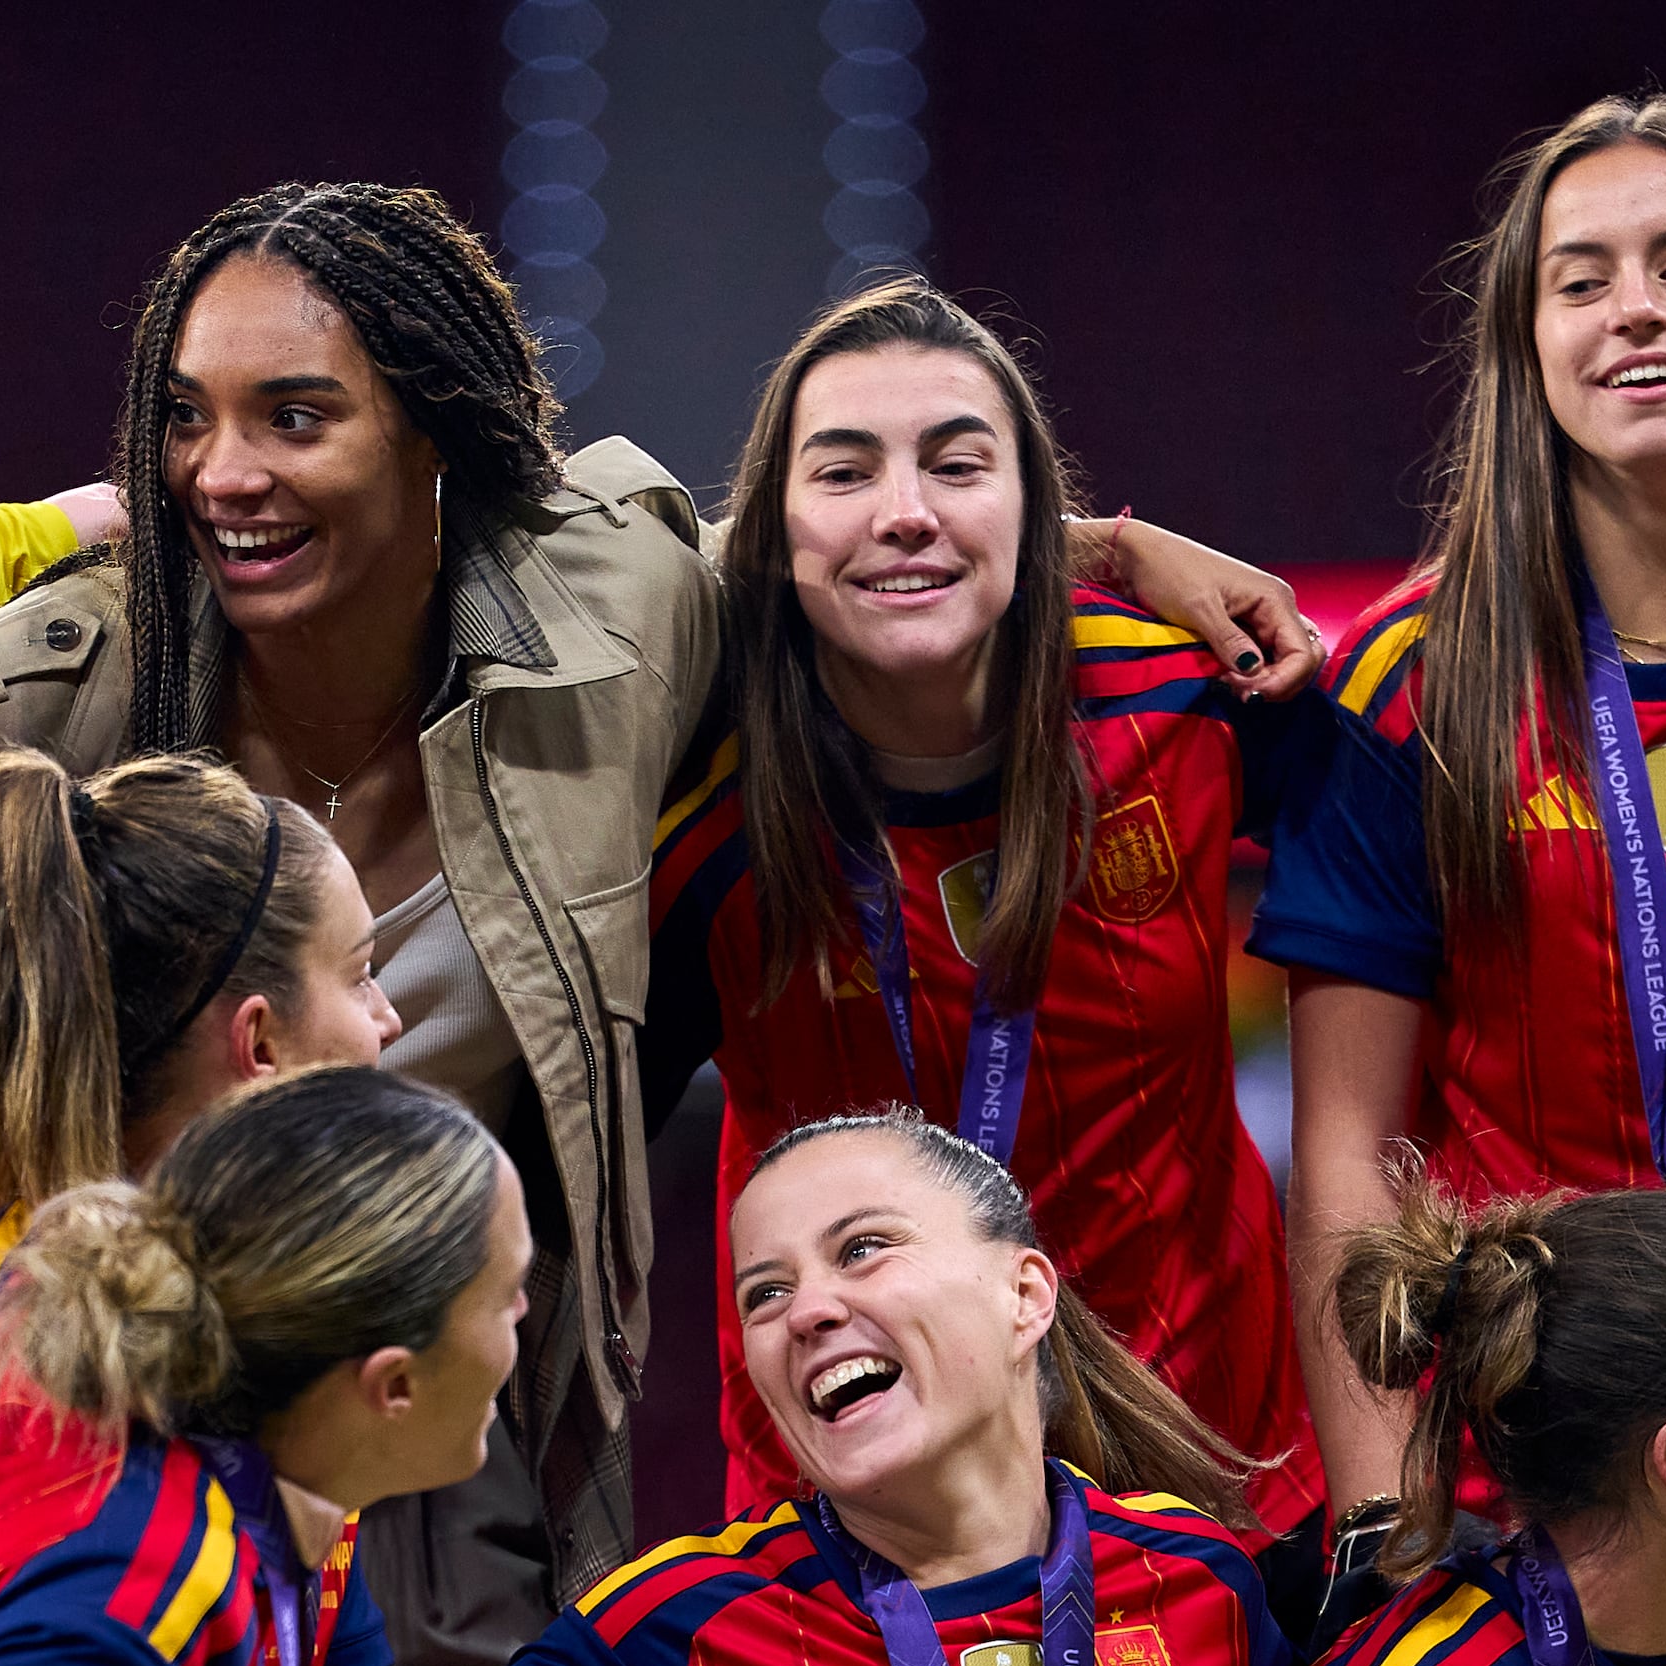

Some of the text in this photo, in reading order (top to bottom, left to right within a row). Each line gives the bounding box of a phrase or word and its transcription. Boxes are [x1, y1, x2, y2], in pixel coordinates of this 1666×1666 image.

[1591, 695, 1619, 752] UEFA
[1604, 748, 1644, 854] WOMEN'S
[1630, 855, 1660, 962] NATIONS
[981, 1018, 1011, 1120] NATIONS
[1540, 1591, 1569, 1648] UEFA
